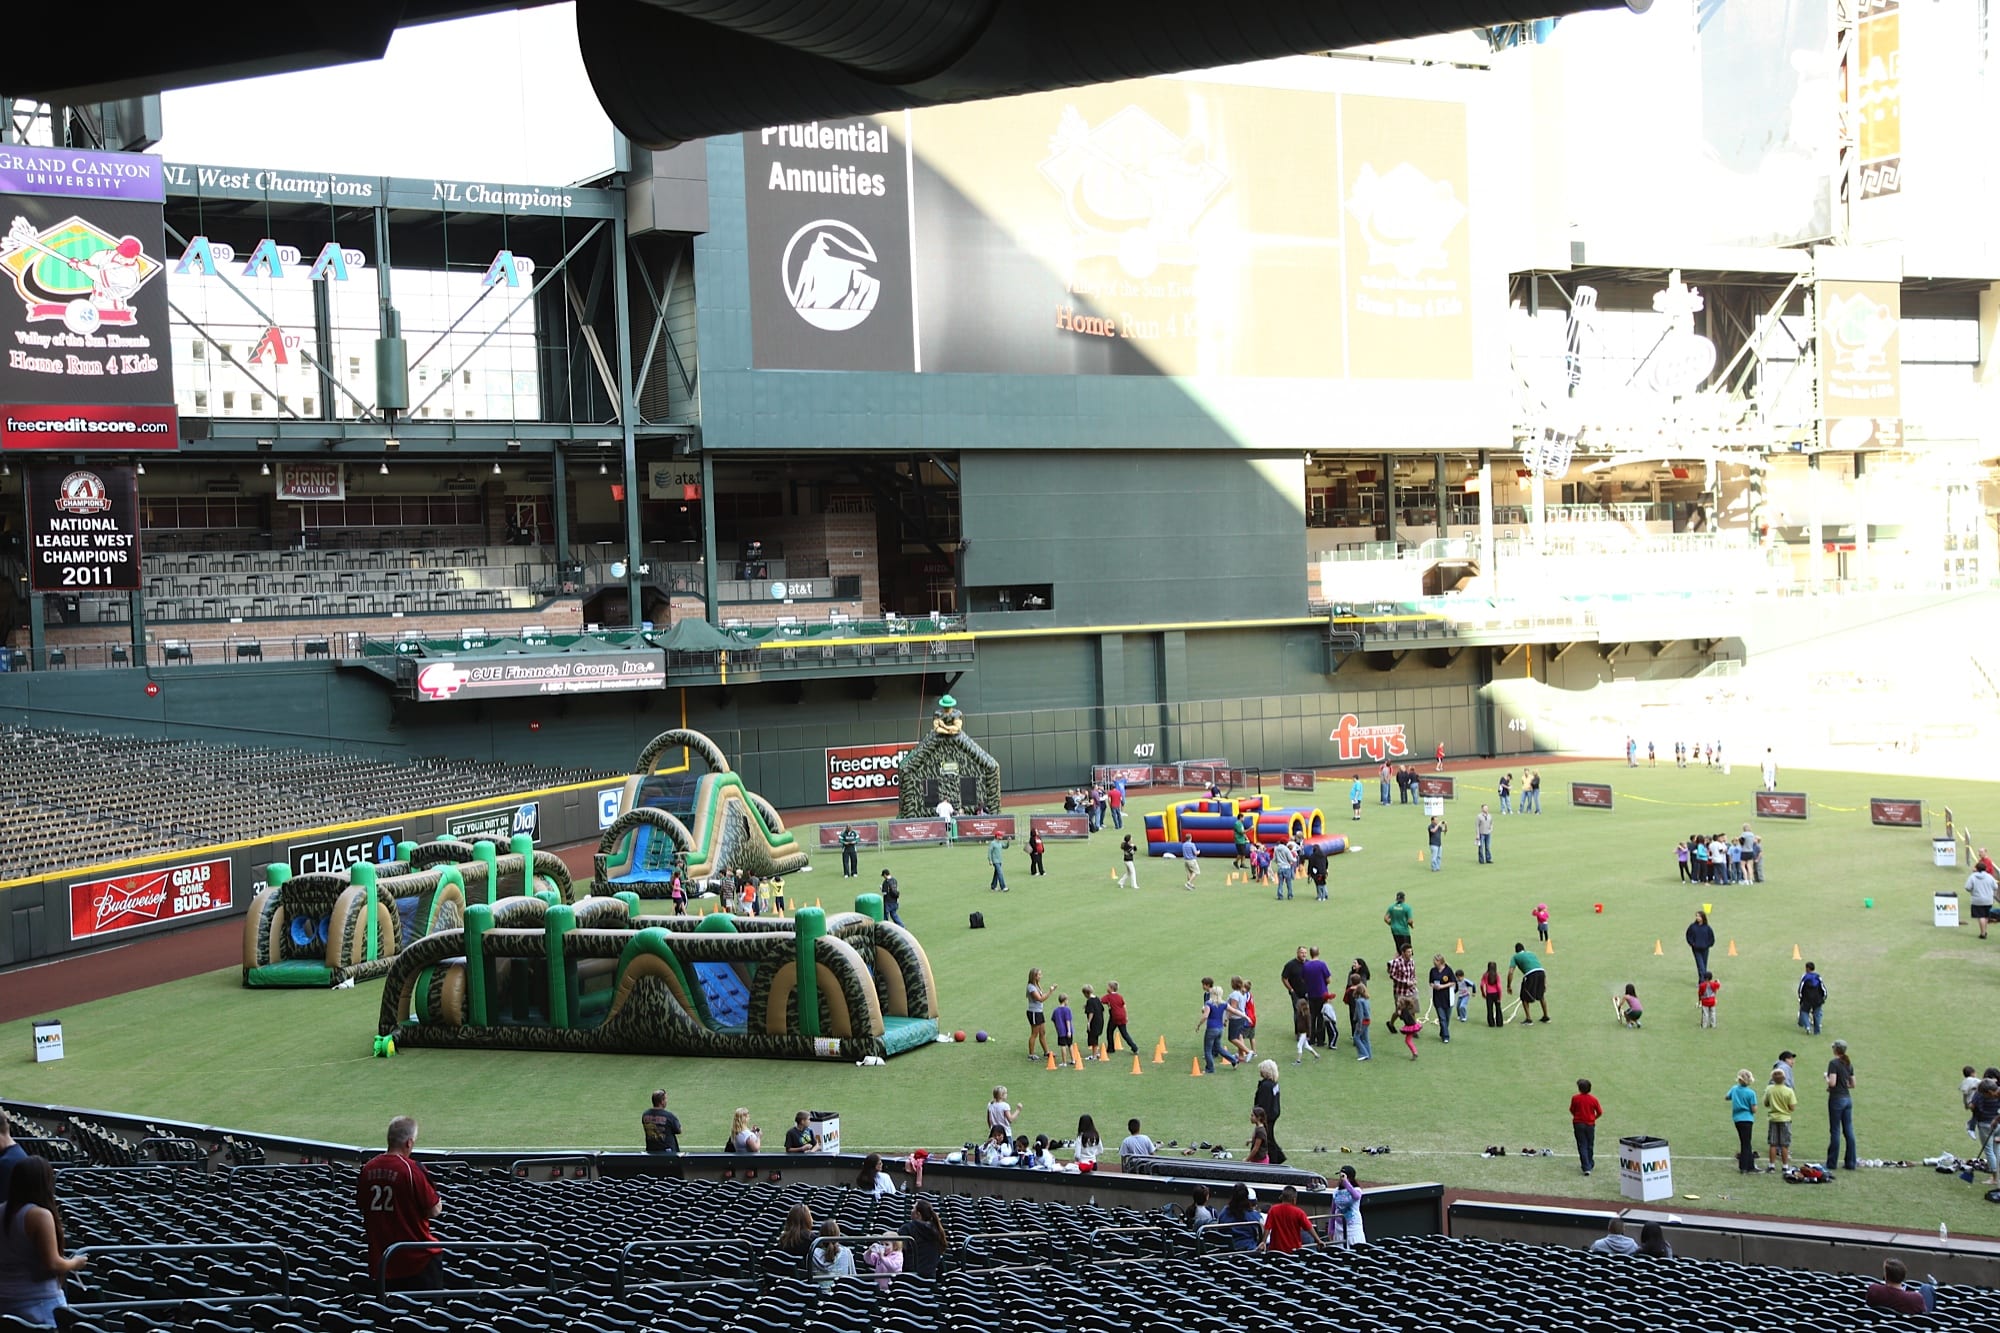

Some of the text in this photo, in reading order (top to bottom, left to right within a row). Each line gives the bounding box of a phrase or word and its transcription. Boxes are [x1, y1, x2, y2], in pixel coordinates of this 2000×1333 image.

[762, 121, 888, 153] Prudential
[0, 153, 150, 178] GRAND CANYON
[27, 173, 120, 188] UNIVERSITY
[164, 166, 373, 198] NL West Champions
[769, 161, 886, 196] Annuities
[432, 182, 572, 210] NL Champions
[213, 247, 230, 259] 99
[281, 250, 295, 262] 01
[345, 252, 361, 265] 02
[517, 260, 530, 272] 01
[1056, 304, 1115, 338] Home
[1121, 312, 1160, 339] Run
[15, 331, 51, 348] Valley
[52, 333, 65, 347] of
[65, 334, 84, 347] the
[85, 334, 106, 347] Sun
[284, 336, 300, 348] 07
[9, 350, 158, 375] Home Run 4 Kids
[7, 418, 168, 433] freecreditscore.com
[285, 472, 335, 486] PICNIC
[675, 472, 701, 485] at&t
[291, 486, 331, 494] PAVILION
[50, 519, 118, 531] NATIONAL
[36, 535, 133, 547] LEAGUE WEST
[43, 551, 127, 563] CHAMPIONS
[62, 566, 112, 585] 2011
[788, 583, 812, 595] at&t
[470, 661, 648, 681] CUE Financial Group, Inc.
[1350, 728, 1369, 736] FOOD
[1508, 718, 1527, 732] 413
[1330, 713, 1406, 761] fry's
[1133, 743, 1155, 757] 407
[830, 751, 908, 773] freecred
[831, 773, 899, 790] score.c
[452, 825, 466, 835] GET
[467, 821, 484, 833] YOUR
[485, 818, 500, 829] DIRT
[500, 816, 509, 825] ON
[513, 811, 535, 831] Dial
[300, 842, 374, 876] CHASE
[172, 866, 211, 887] GRAB
[180, 883, 204, 896] SOME
[253, 881, 268, 899] 37
[94, 891, 168, 919] Budweiser
[174, 893, 211, 913] BUDS
[37, 1034, 60, 1043] WM
[824, 1130, 838, 1143] WM
[1620, 1157, 1640, 1172] WM
[1643, 1159, 1667, 1173] WM
[370, 1185, 394, 1211] 22
